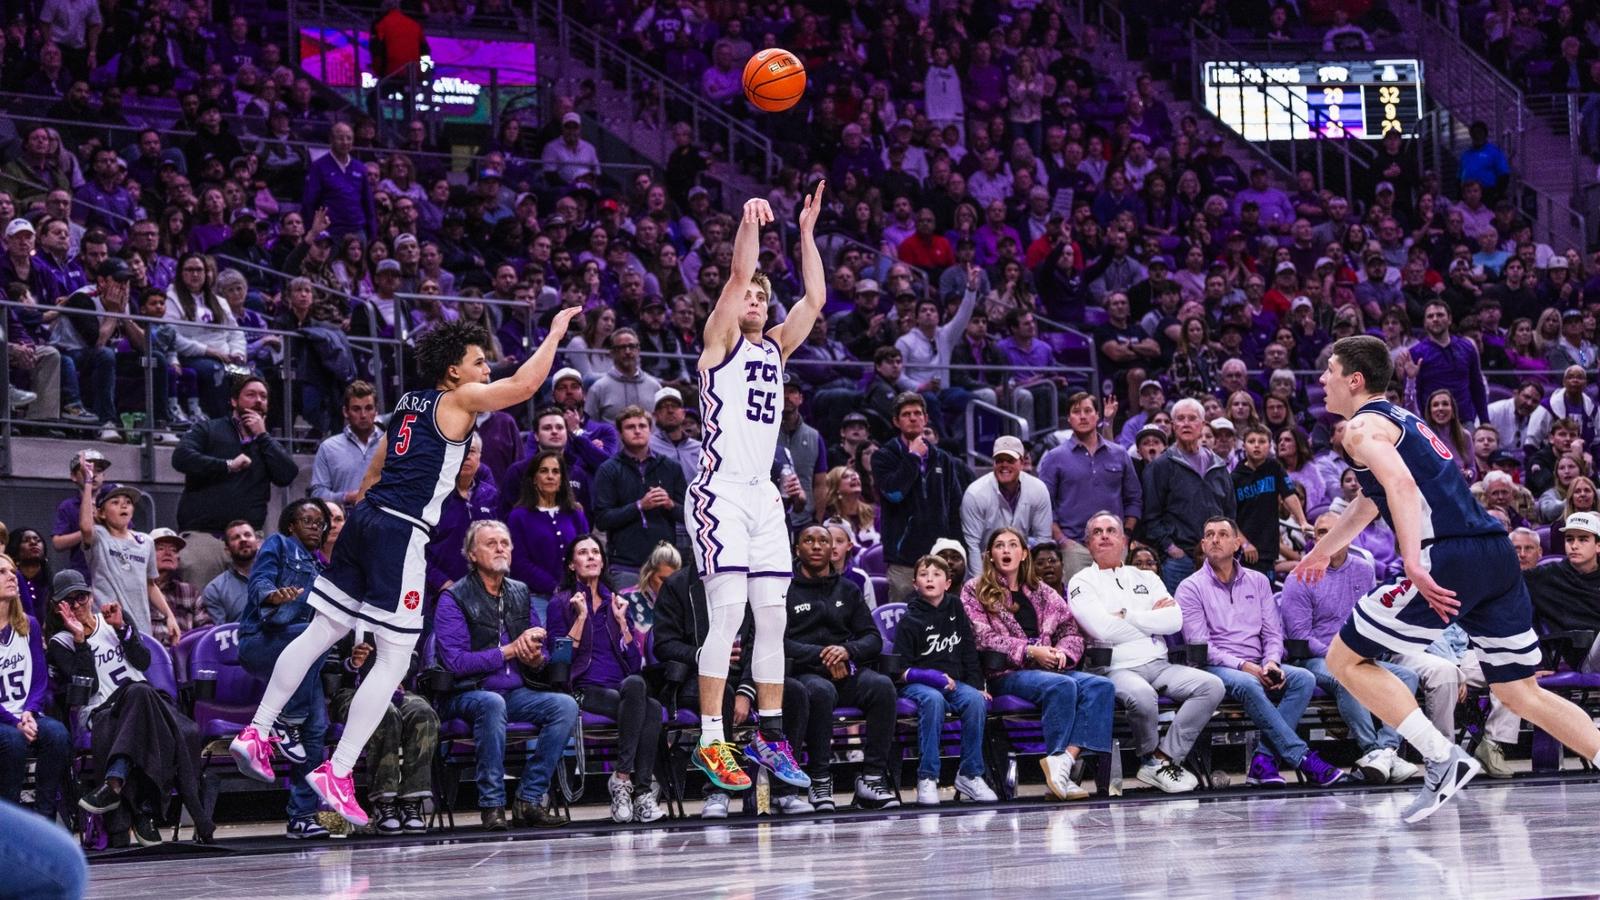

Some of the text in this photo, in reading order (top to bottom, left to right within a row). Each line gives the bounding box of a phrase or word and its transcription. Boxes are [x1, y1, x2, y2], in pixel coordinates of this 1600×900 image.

[1379, 86, 1400, 104] 32
[1384, 103, 1396, 120] 9
[746, 387, 776, 424] 55
[395, 414, 417, 456] 5
[1416, 421, 1453, 460] 8
[794, 603, 811, 614] TCU
[879, 609, 905, 630] TC
[215, 628, 239, 652] TC
[920, 631, 962, 656] Frogs
